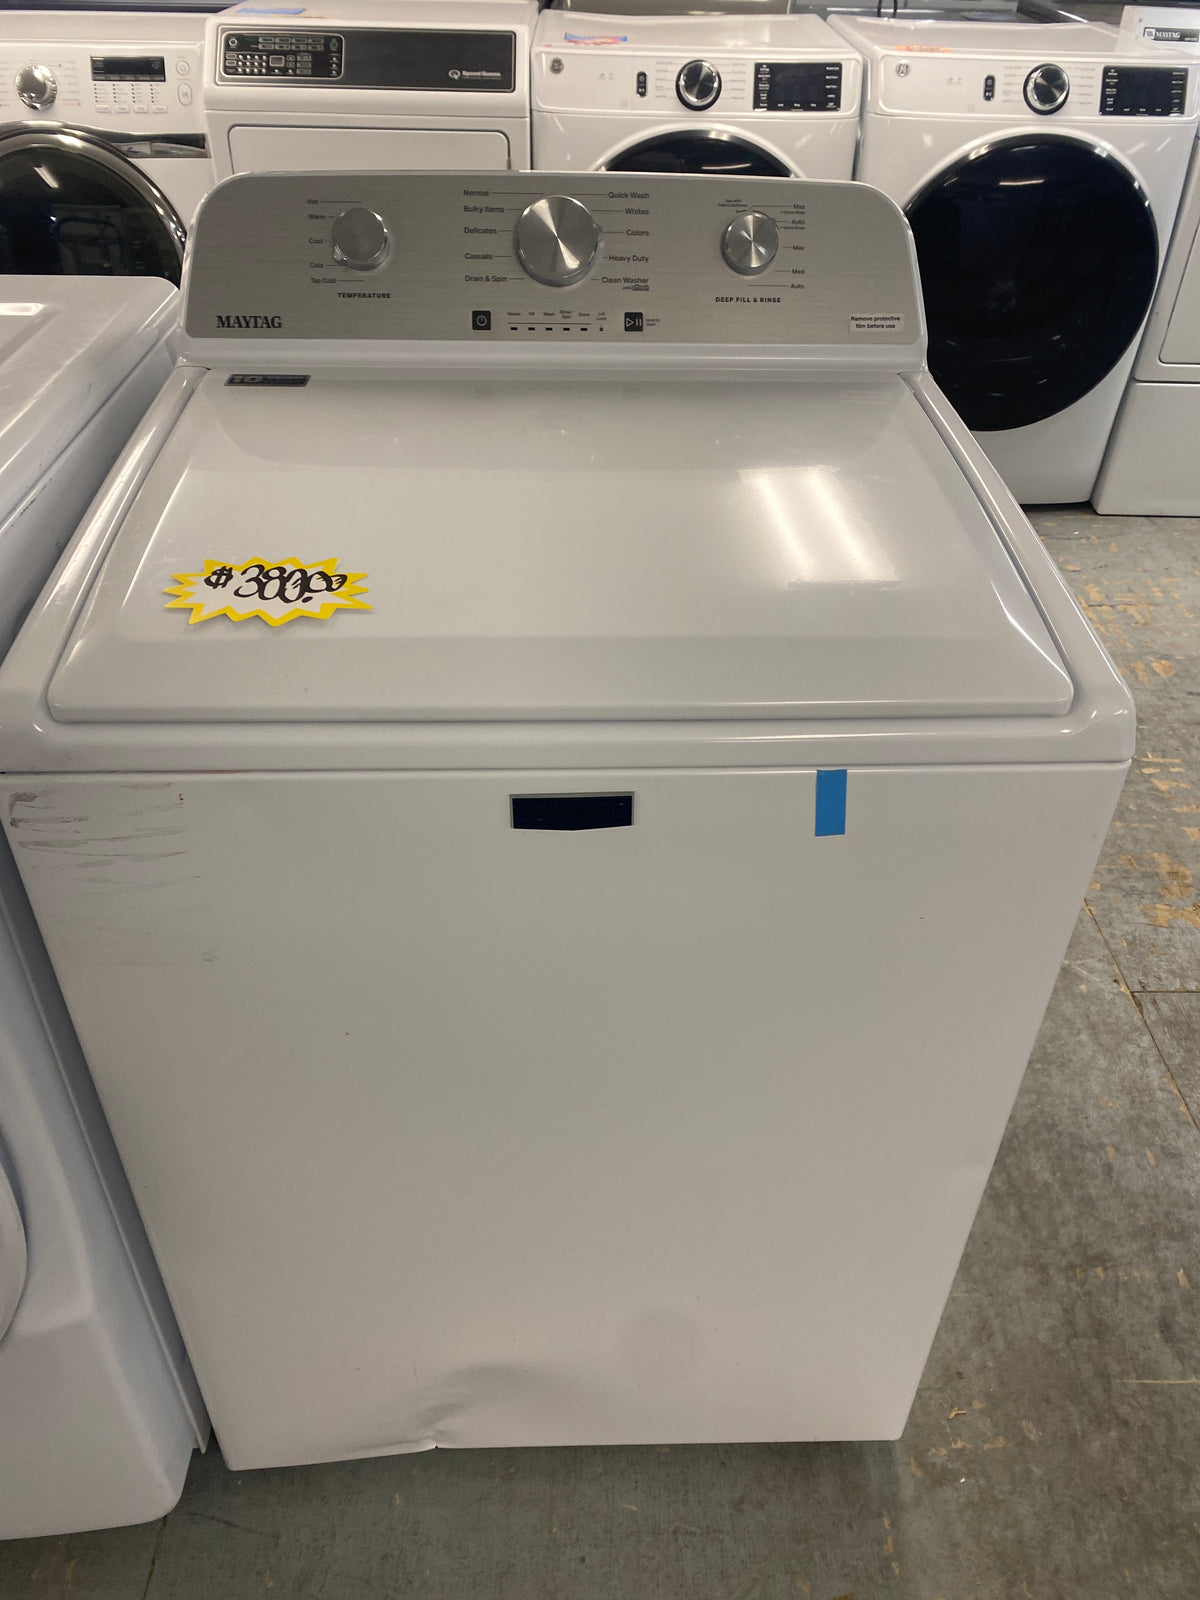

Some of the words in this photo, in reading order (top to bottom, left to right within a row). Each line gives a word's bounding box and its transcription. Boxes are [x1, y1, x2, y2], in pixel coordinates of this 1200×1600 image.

[608, 191, 628, 199] Quick
[629, 191, 649, 199] Wash
[463, 206, 484, 214] Bulky
[464, 227, 497, 235] Delicates
[465, 252, 493, 260] Casuals
[609, 254, 632, 263] Heavy
[633, 254, 649, 263] Duty
[491, 275, 507, 284] Spin
[601, 276, 621, 284] Clean
[622, 276, 649, 284] Washer
[216, 315, 282, 329] MAYTAG
